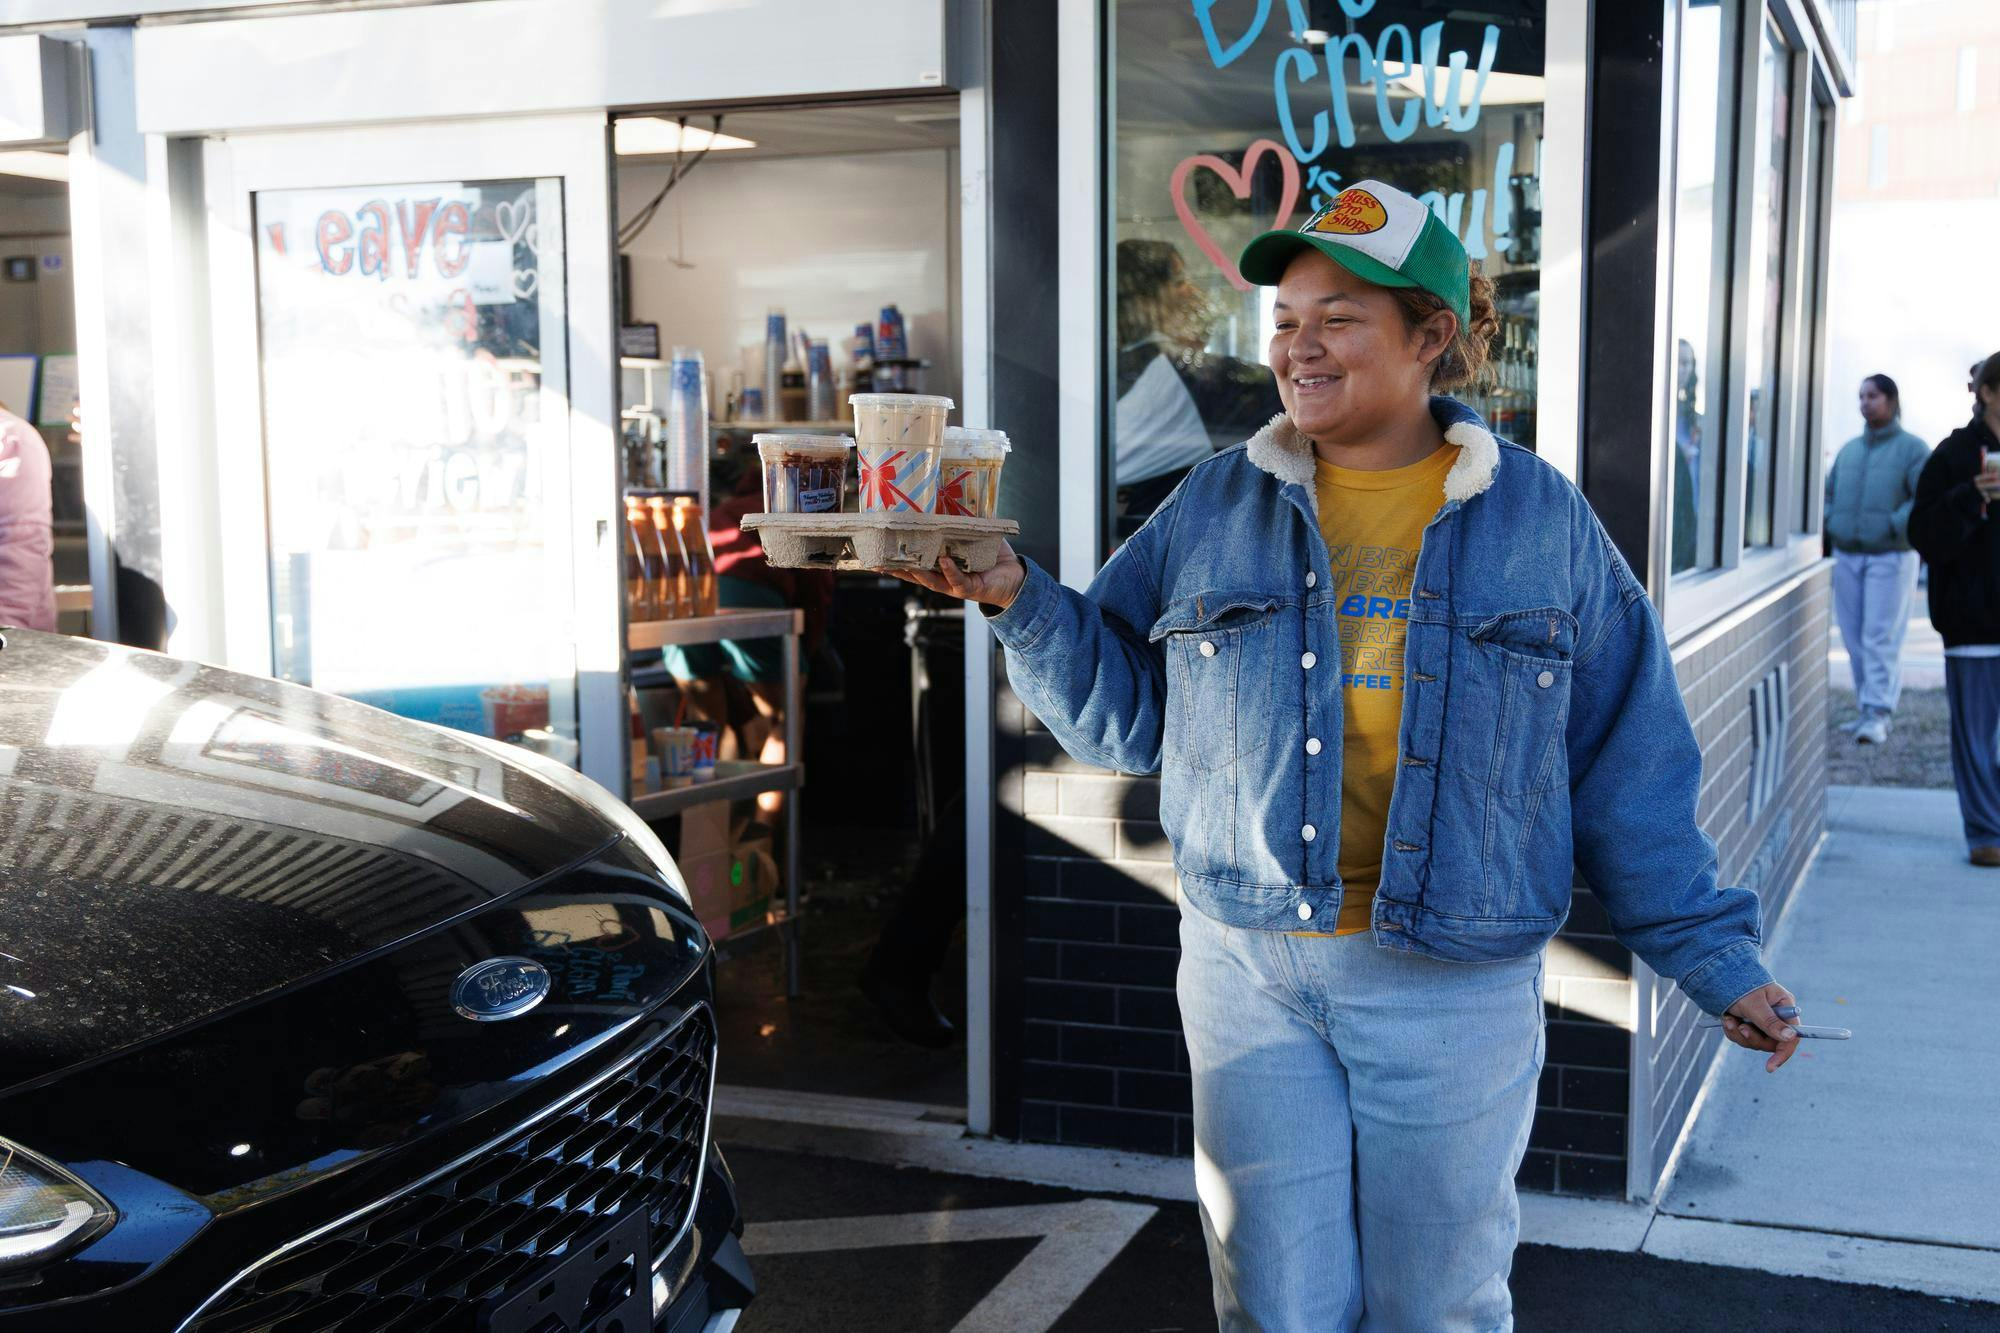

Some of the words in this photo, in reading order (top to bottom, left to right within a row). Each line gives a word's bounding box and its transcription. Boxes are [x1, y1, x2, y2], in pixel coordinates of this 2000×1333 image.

[1274, 22, 1500, 164] crew
[1342, 190, 1377, 208] Bass
[1338, 203, 1362, 216] Pro
[1328, 212, 1373, 232] Shops
[478, 967, 534, 1007] Ford
